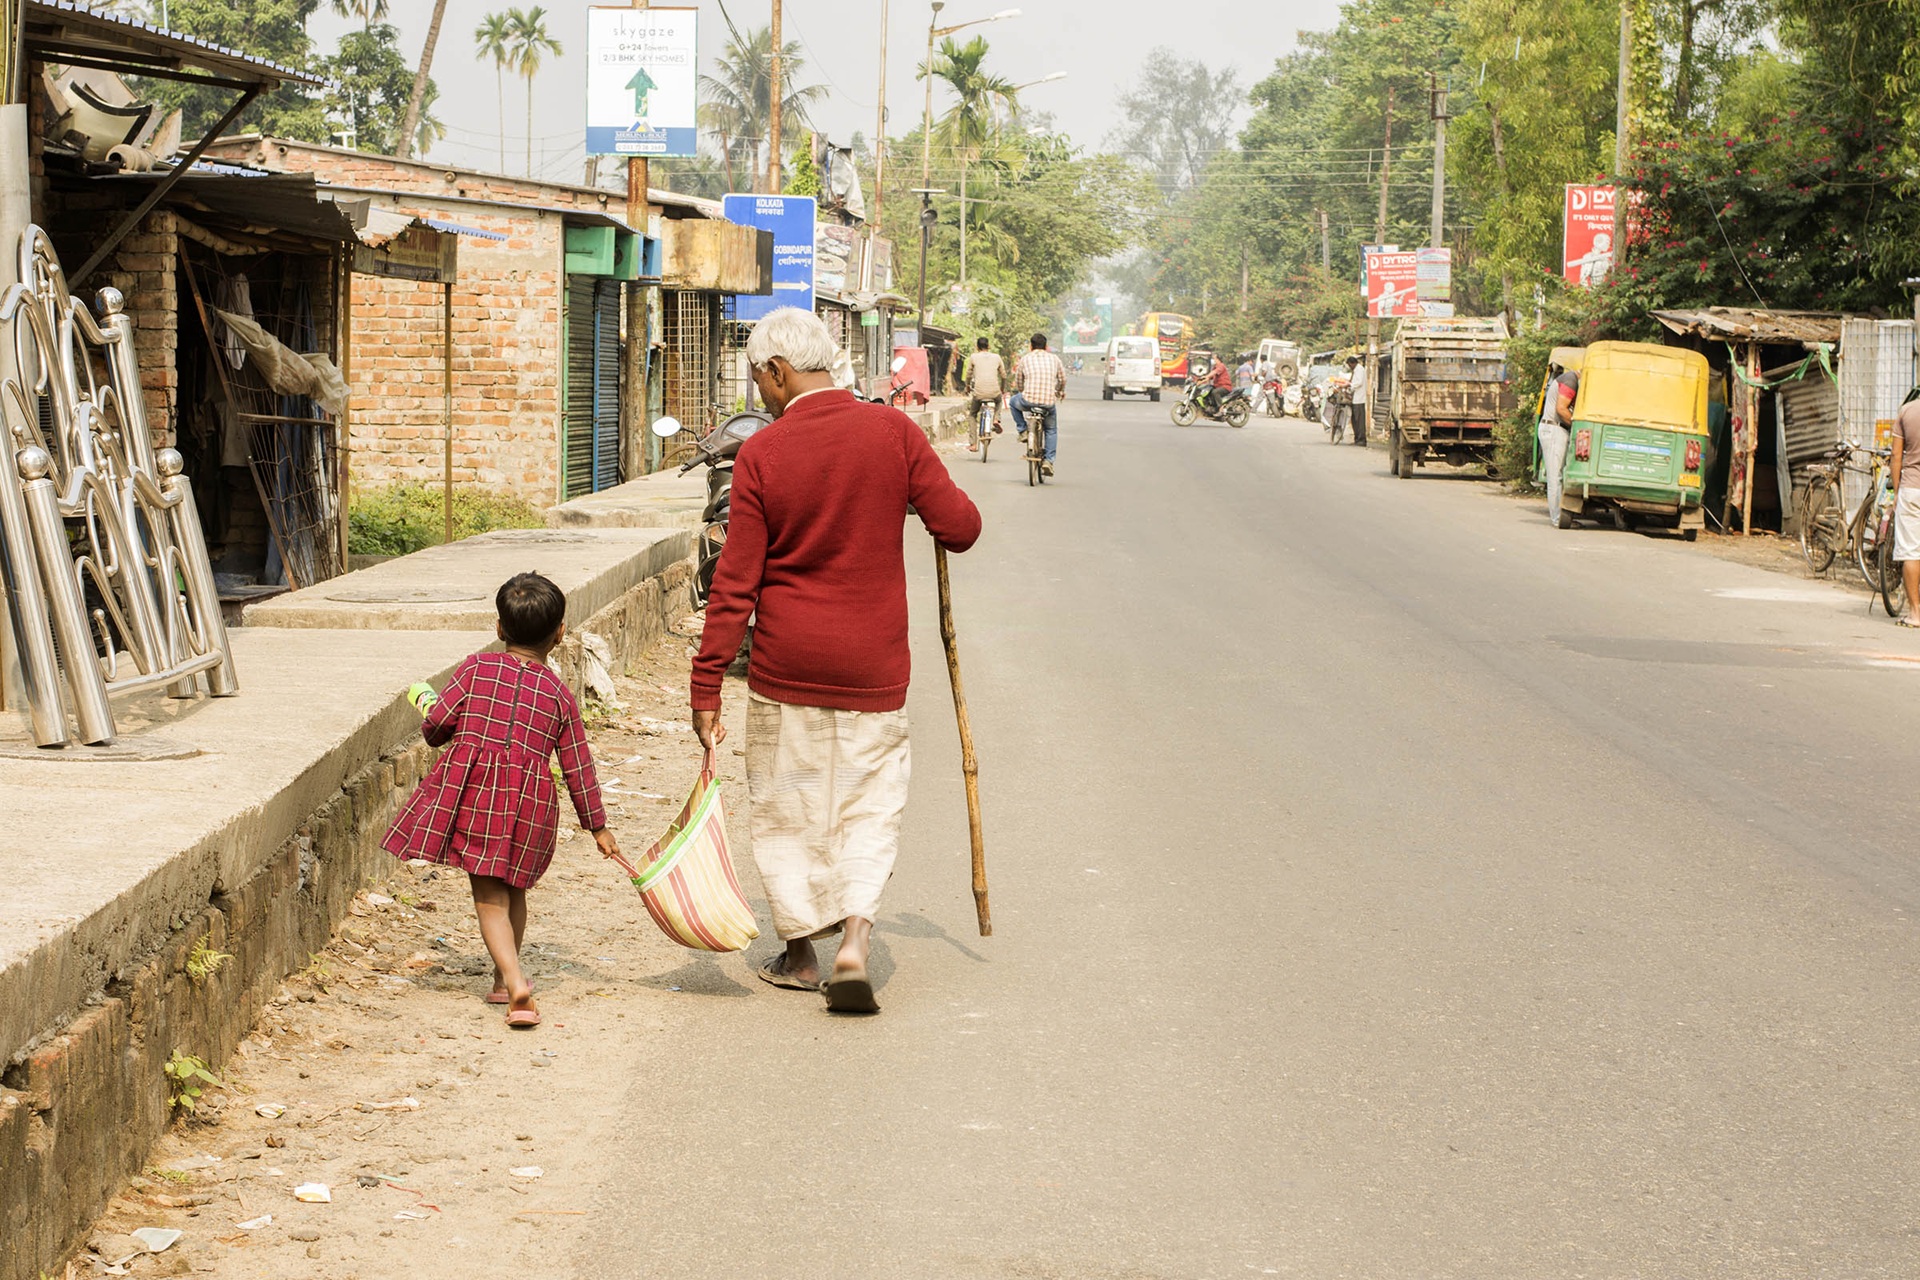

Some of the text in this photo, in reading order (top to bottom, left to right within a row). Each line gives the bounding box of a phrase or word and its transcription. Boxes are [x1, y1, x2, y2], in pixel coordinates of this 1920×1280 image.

[613, 14, 674, 38] skygaze
[756, 199, 784, 207] KOLKATA
[774, 245, 812, 255] GOBINDAPUR
